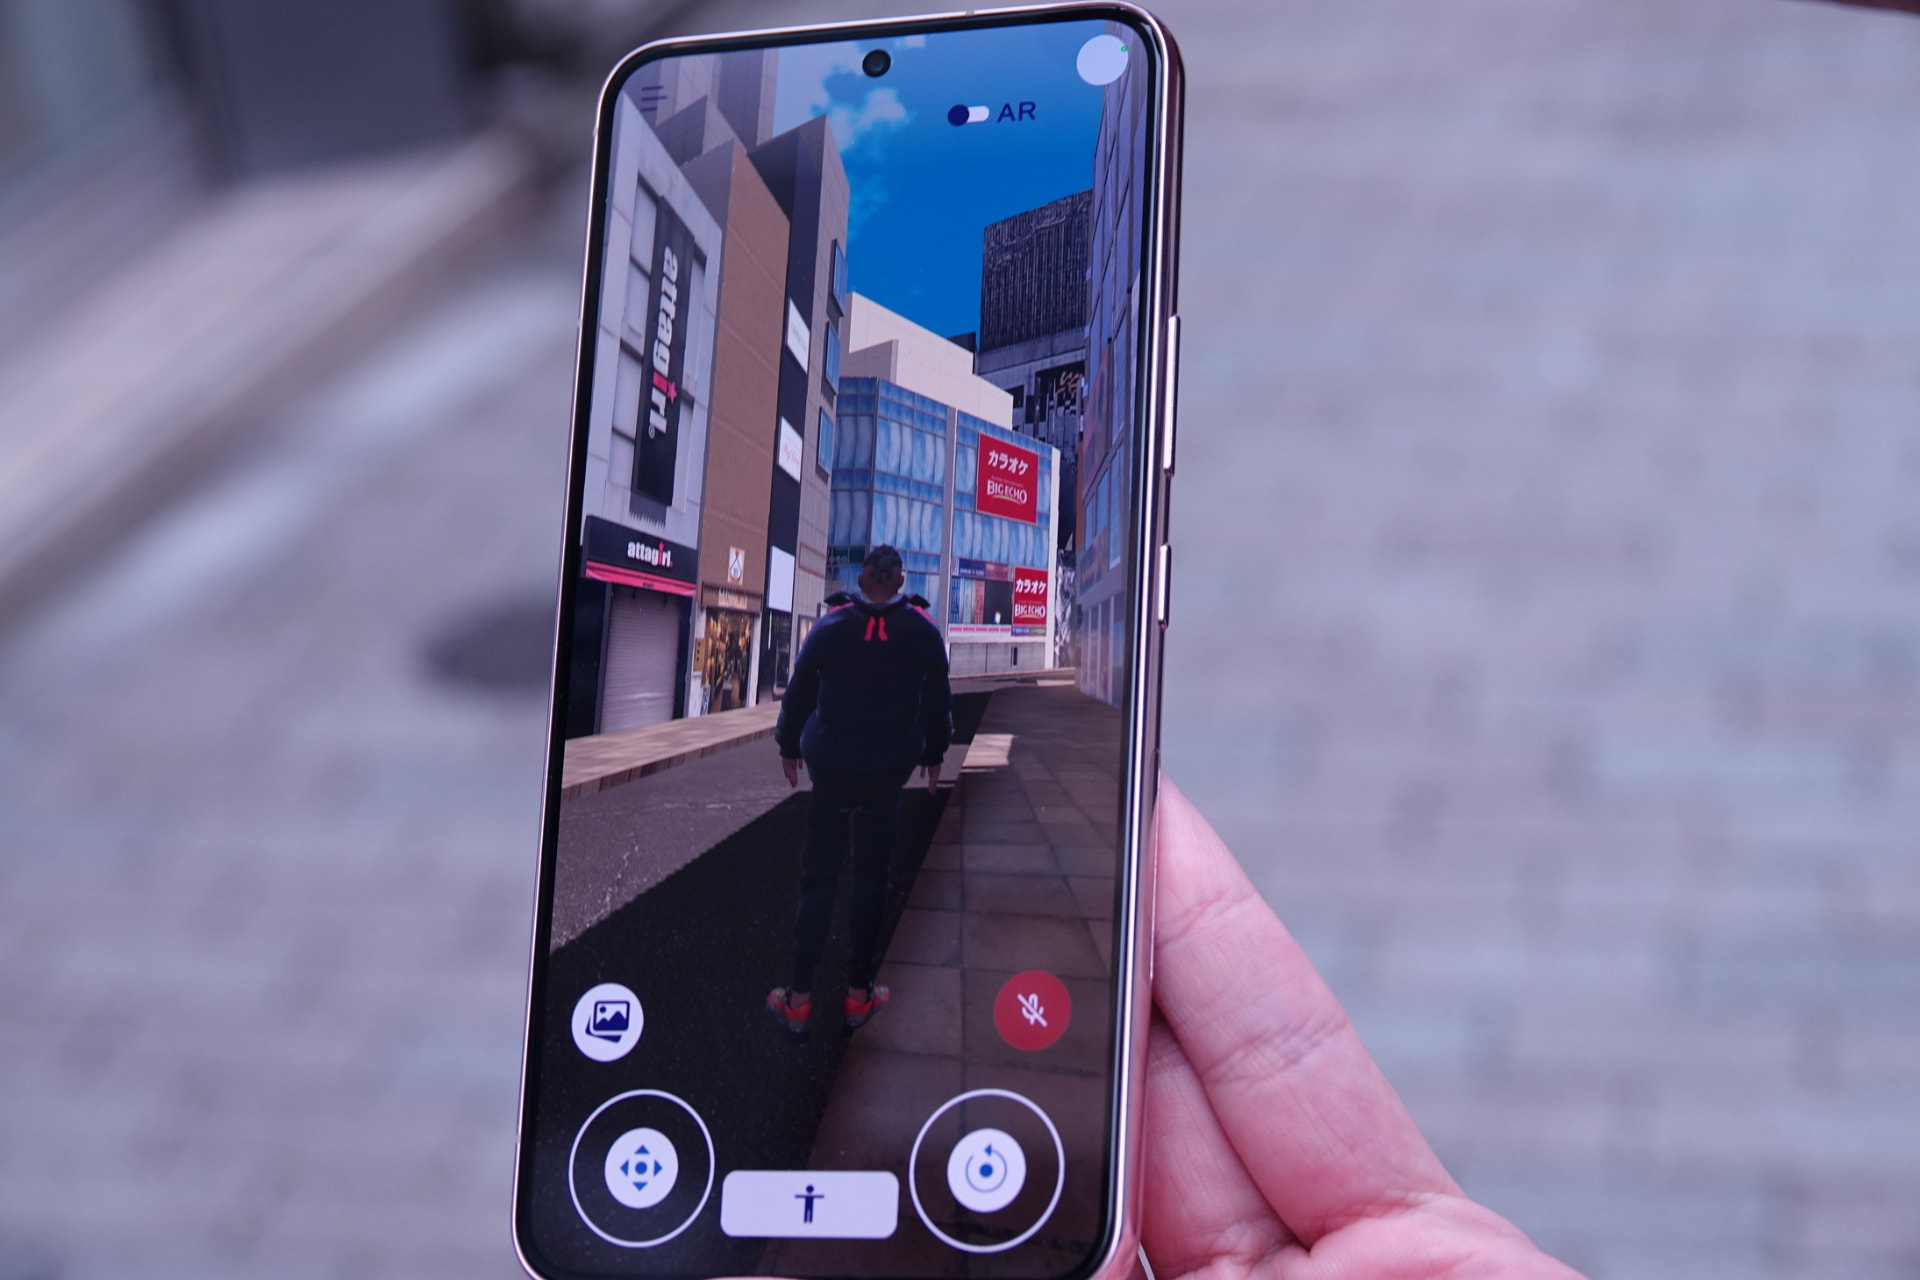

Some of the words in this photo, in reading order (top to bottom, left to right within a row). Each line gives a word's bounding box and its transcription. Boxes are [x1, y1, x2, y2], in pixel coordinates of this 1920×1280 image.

[996, 101, 1036, 123] AR
[988, 449, 1029, 476] カラオケ
[1016, 578, 1046, 594] カラオケ
